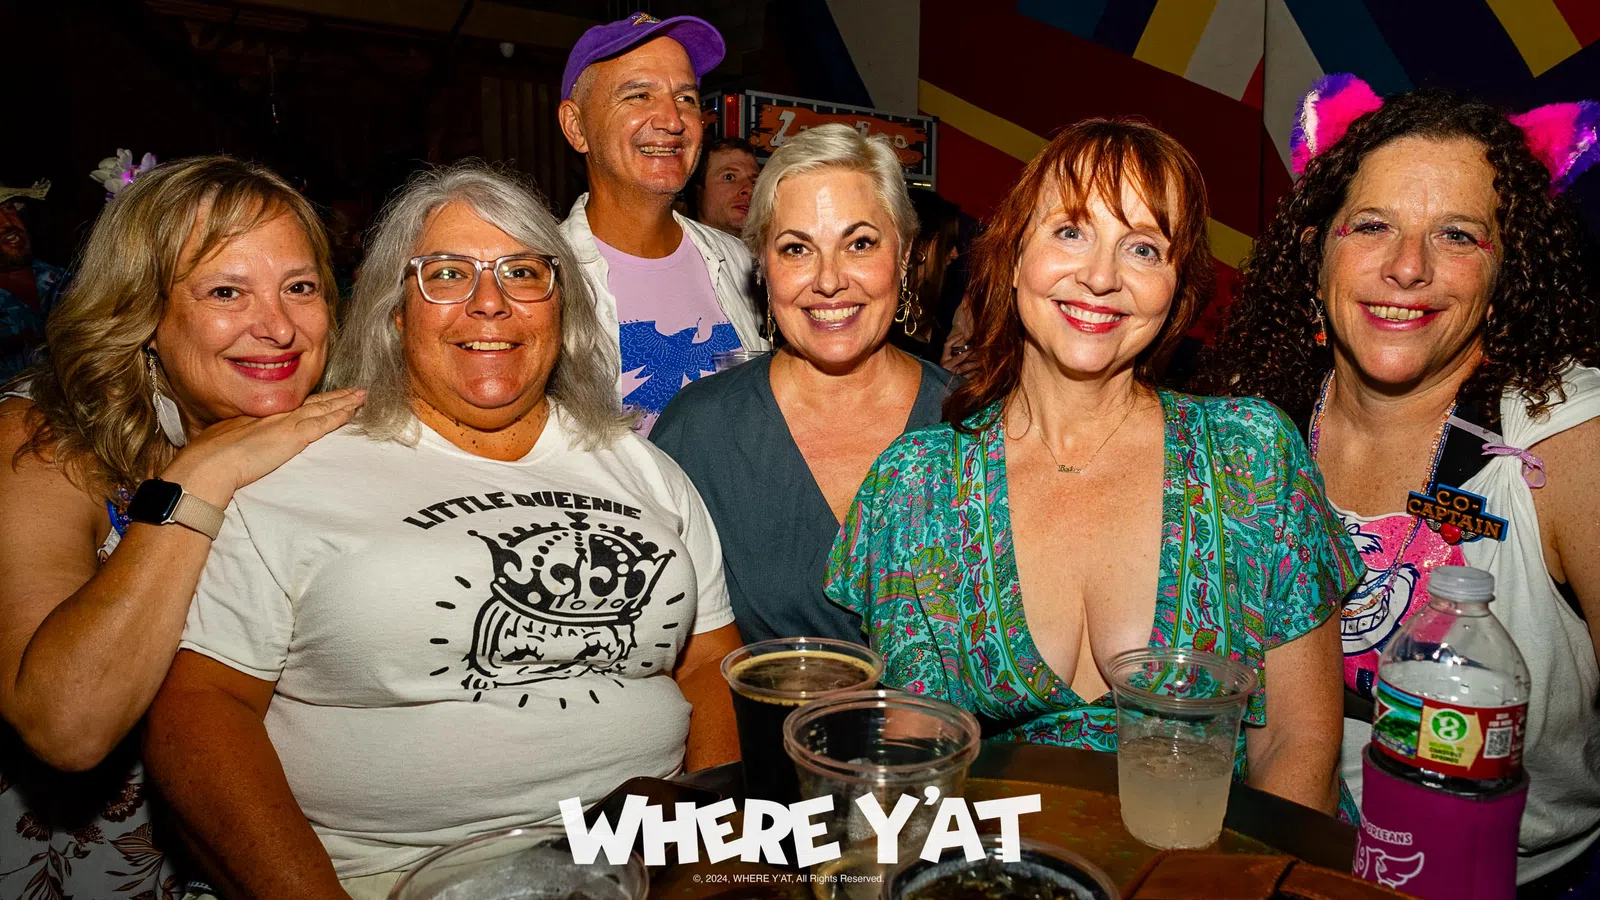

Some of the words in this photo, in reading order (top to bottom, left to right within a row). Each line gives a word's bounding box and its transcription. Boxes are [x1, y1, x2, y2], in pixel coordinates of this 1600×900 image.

[403, 491, 513, 530] LITTLE
[512, 491, 641, 520] QUEENIE
[1408, 499, 1501, 539] CAPTAIN
[1366, 823, 1412, 844] ORLEANS
